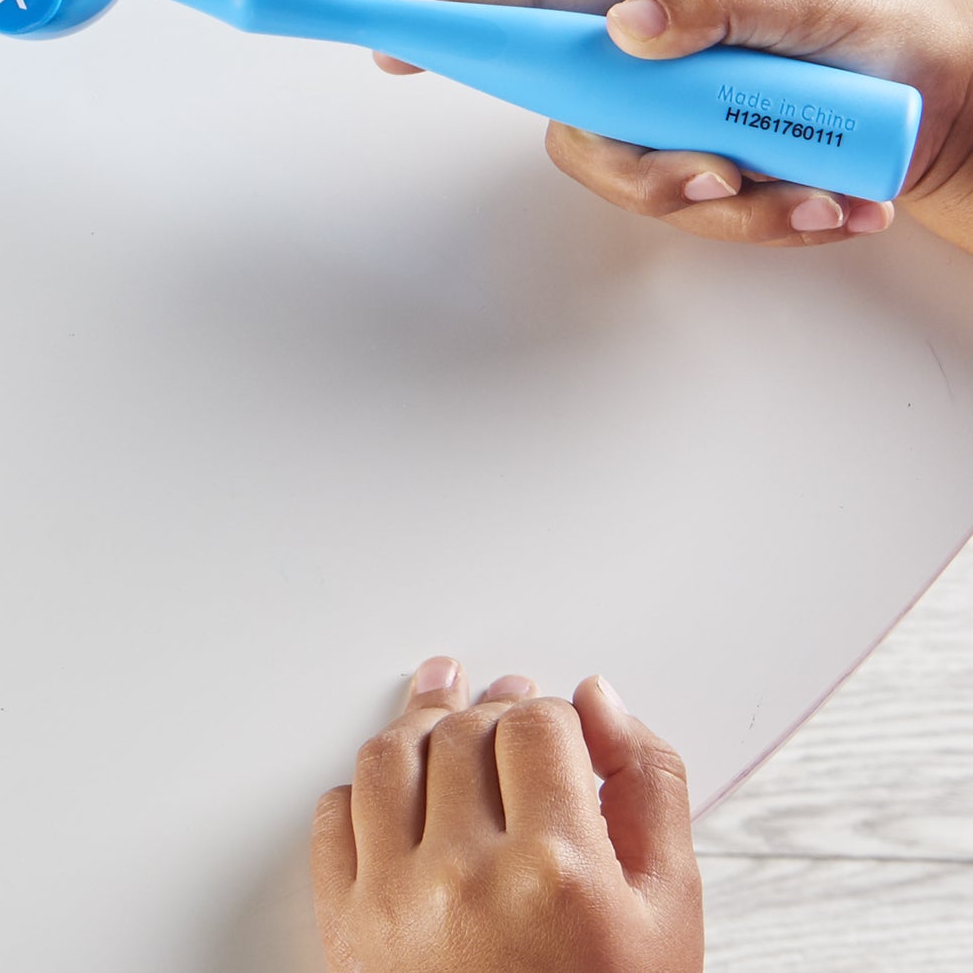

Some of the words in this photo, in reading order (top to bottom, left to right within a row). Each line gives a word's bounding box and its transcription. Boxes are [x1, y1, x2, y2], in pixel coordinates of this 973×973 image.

[716, 84, 771, 112] Made
[779, 99, 796, 117] in
[800, 105, 856, 132] China
[725, 107, 844, 147] H1261760111
